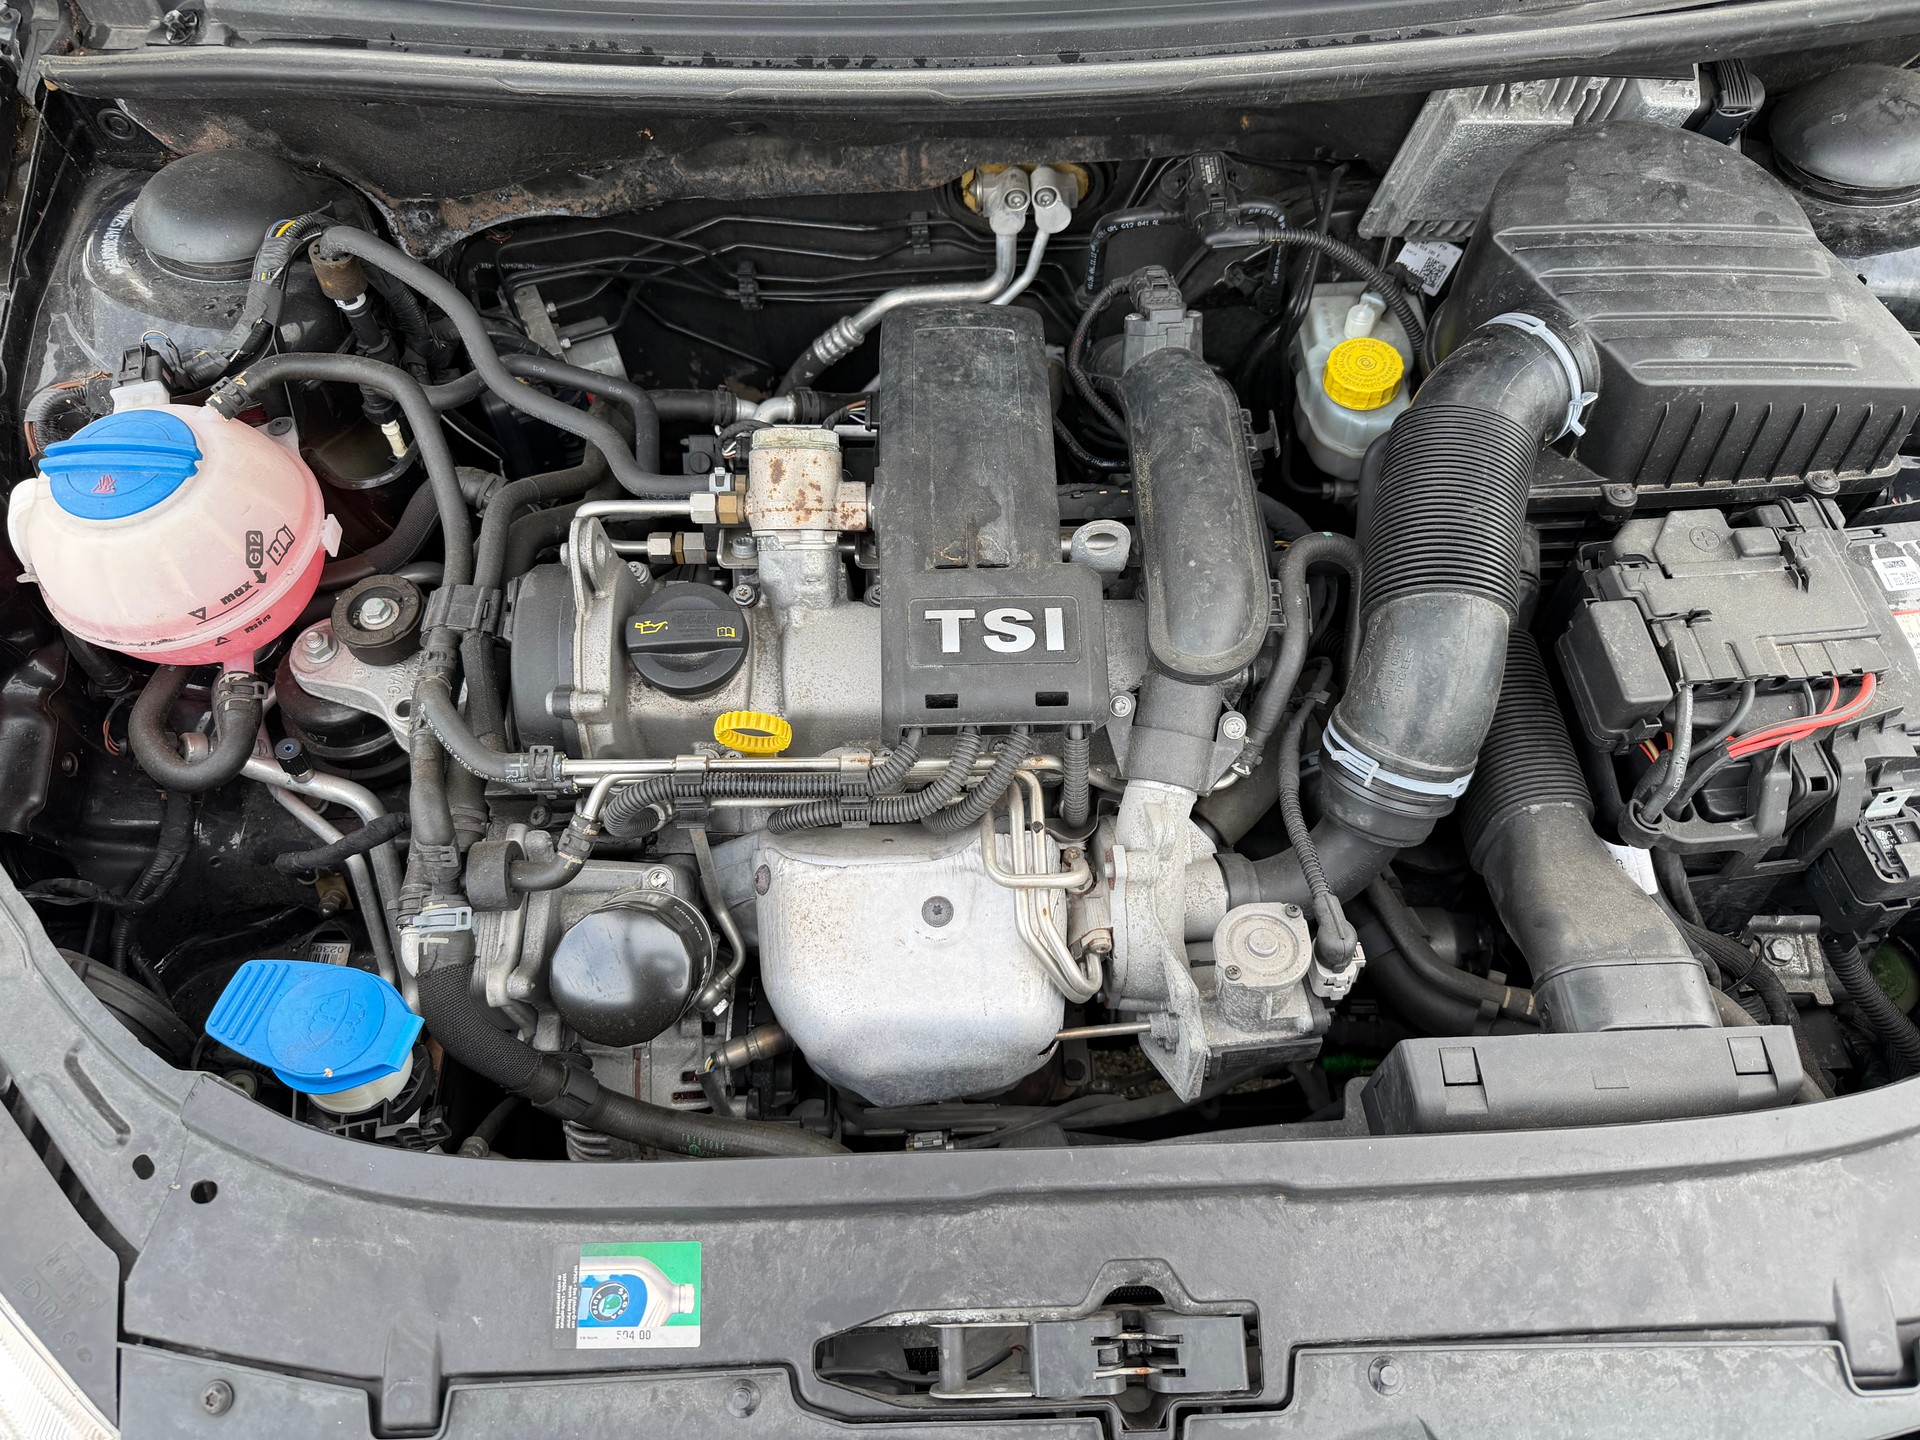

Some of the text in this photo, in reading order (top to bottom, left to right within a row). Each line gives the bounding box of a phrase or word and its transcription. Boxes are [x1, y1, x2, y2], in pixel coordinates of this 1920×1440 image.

[250, 534, 260, 564] G12
[220, 580, 253, 605] max
[244, 614, 272, 633] min
[924, 608, 1065, 653] TSI
[639, 1330, 651, 1340] 00
